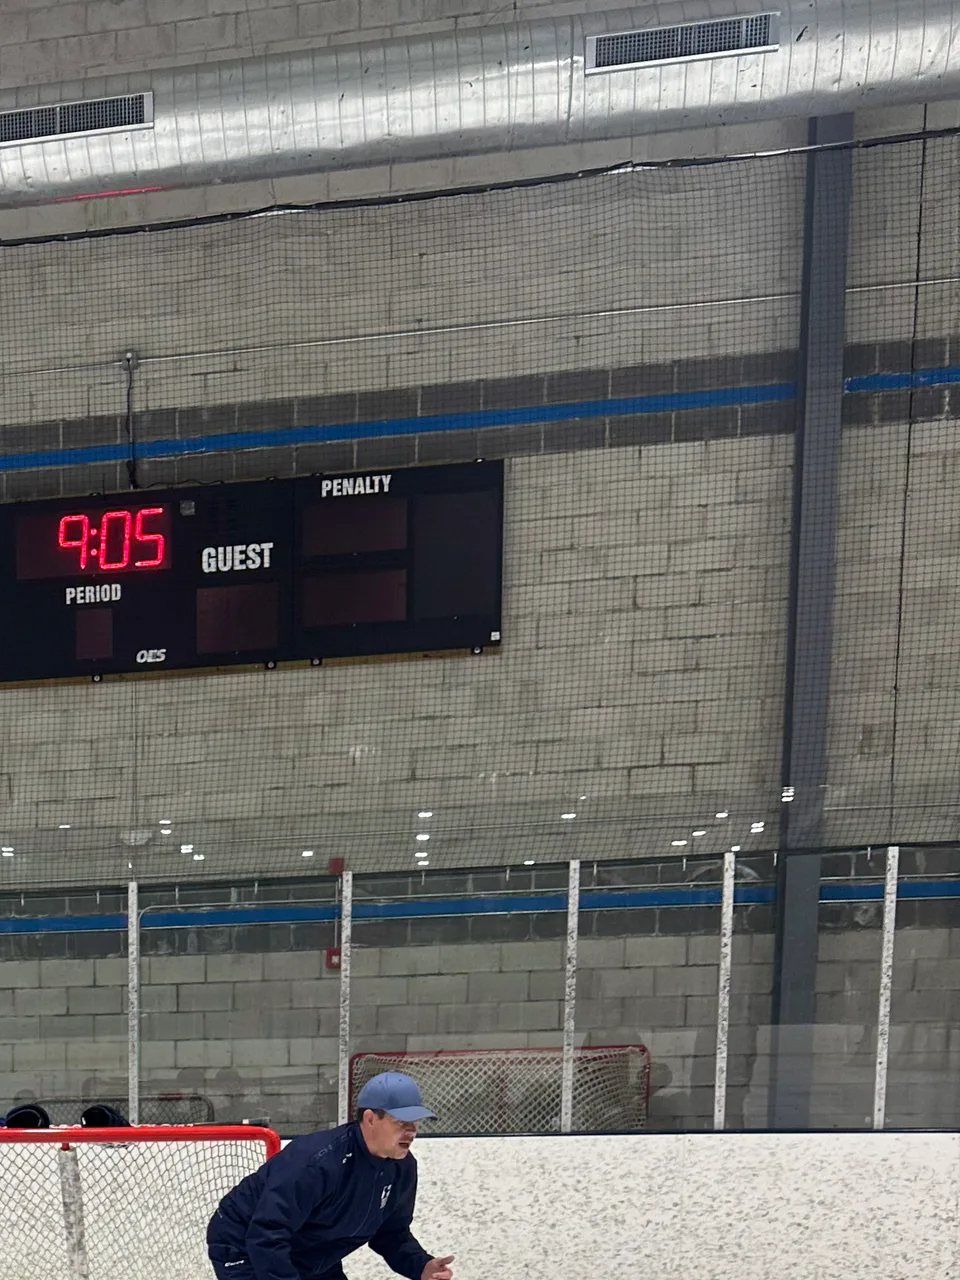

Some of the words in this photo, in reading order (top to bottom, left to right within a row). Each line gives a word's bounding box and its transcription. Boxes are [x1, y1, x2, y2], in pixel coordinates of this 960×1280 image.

[321, 474, 392, 498] PENALTY
[58, 508, 165, 570] 9:05
[201, 542, 274, 574] GUEST
[65, 583, 122, 605] PERIOD
[136, 648, 167, 663] OES
